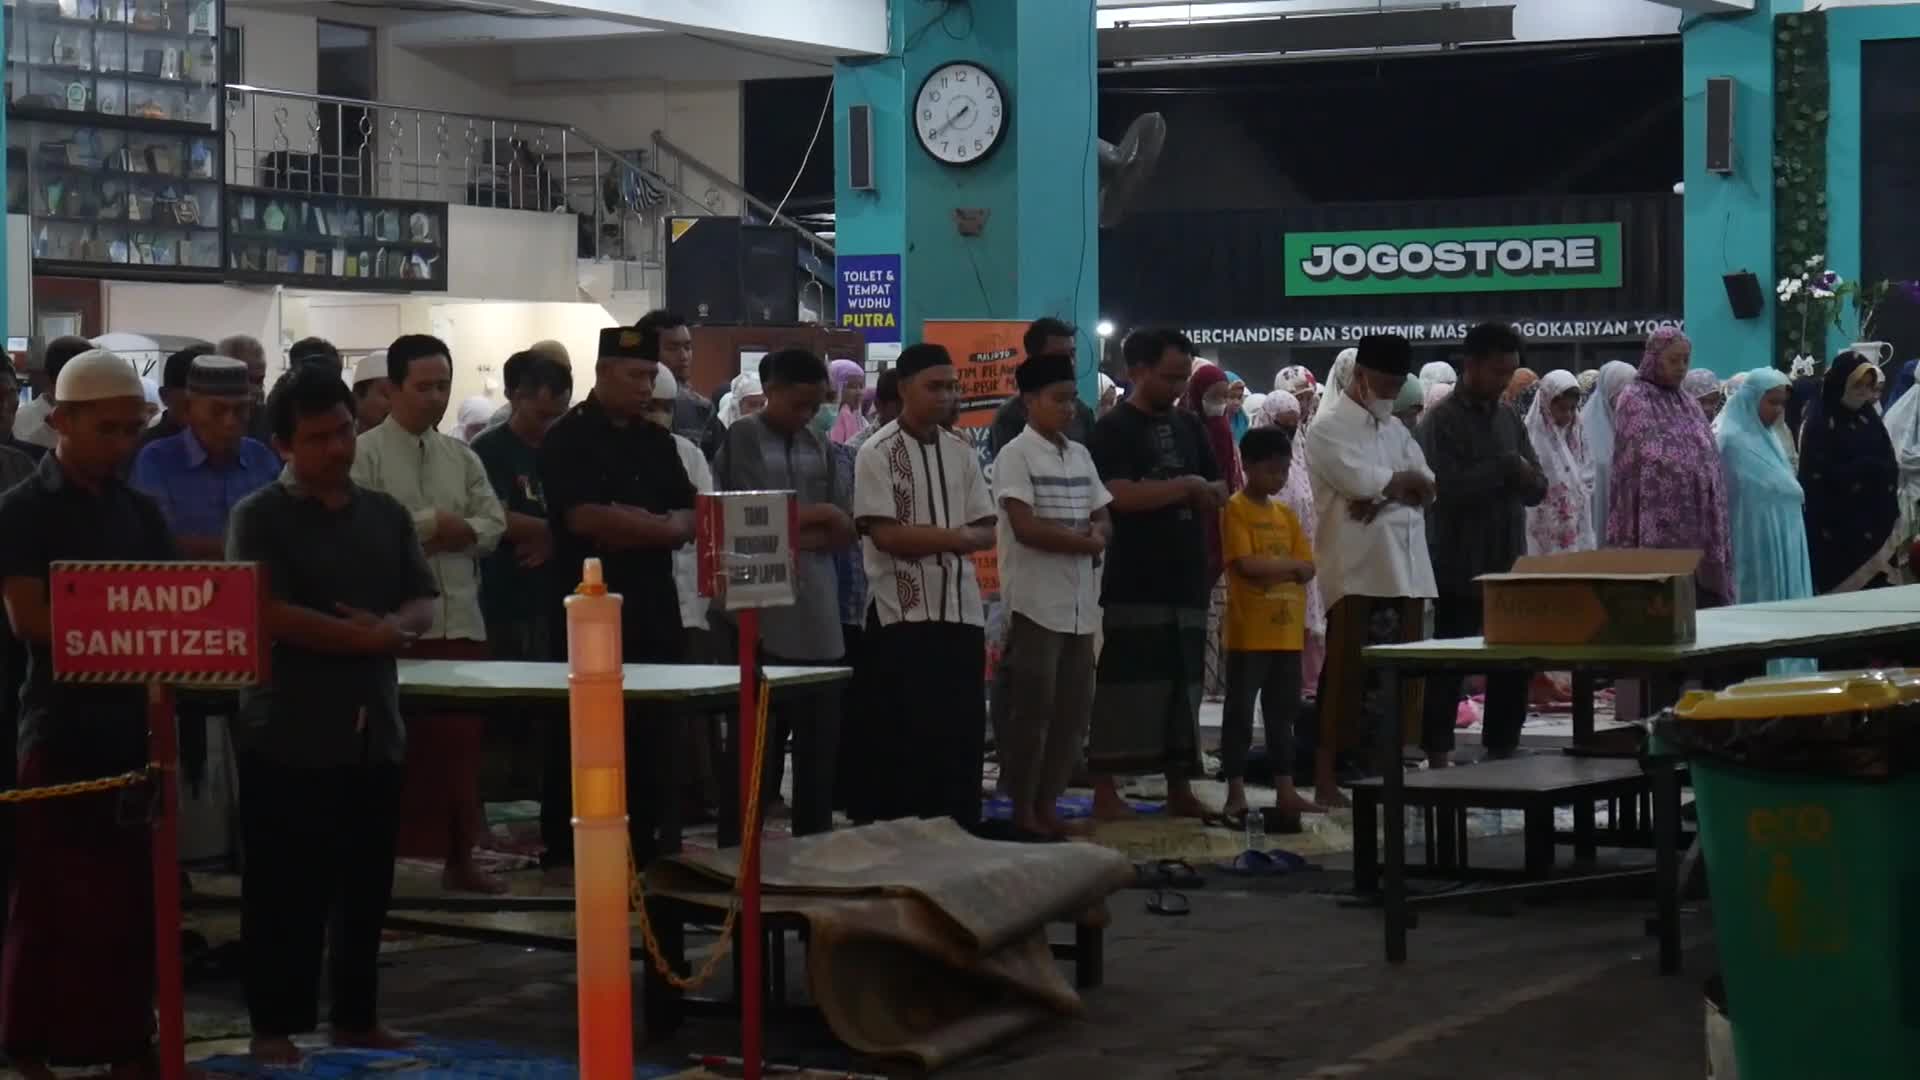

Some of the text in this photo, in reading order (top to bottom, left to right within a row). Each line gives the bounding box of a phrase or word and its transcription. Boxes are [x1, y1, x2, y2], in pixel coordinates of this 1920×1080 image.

[941, 77, 948, 88] 11
[955, 71, 967, 82] 12
[930, 90, 941, 102] 10
[985, 87, 994, 99] 2
[924, 110, 932, 121] 9
[992, 106, 1000, 117] 3
[929, 128, 937, 140] 8
[985, 125, 994, 137] 4
[941, 141, 949, 153] 7
[958, 145, 966, 157] 6
[974, 139, 983, 151] 5
[1302, 237, 1596, 276] JOGOSTORE
[843, 270, 895, 282] TOILET &
[847, 284, 891, 296] TEMPAT
[848, 297, 891, 309] WUDHU
[843, 313, 895, 327] PUTRA
[1300, 326, 1335, 342] DAN
[107, 585, 201, 611] HAND
[65, 629, 248, 656] SANITIZER
